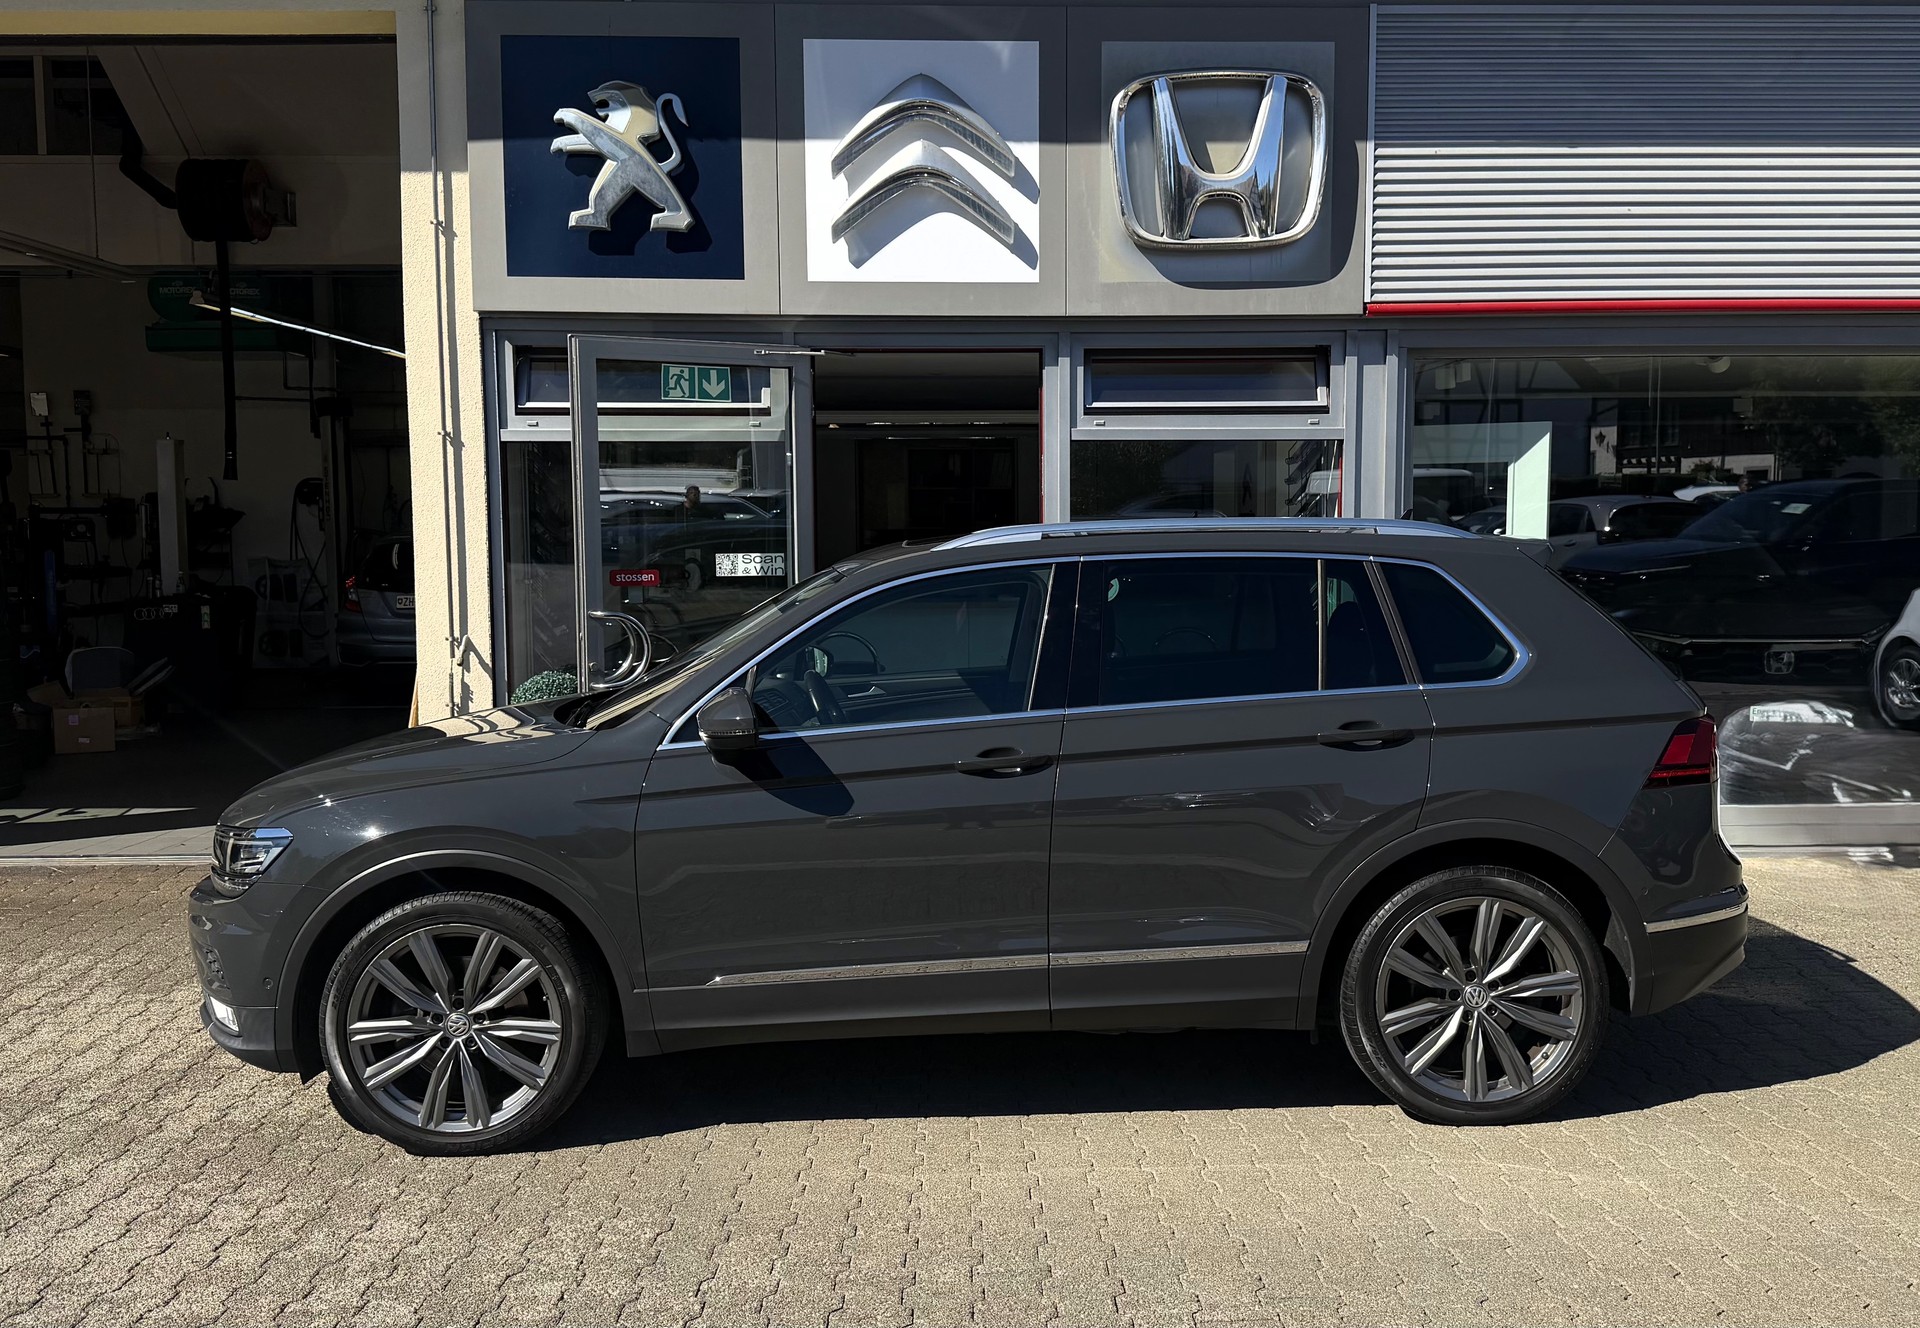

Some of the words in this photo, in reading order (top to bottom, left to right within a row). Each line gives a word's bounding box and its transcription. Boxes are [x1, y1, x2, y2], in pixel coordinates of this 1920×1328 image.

[229, 287, 260, 295] OTOREX
[741, 553, 785, 564] Scan
[742, 566, 752, 575] &
[754, 565, 785, 576] Win
[616, 572, 655, 582] stossen
